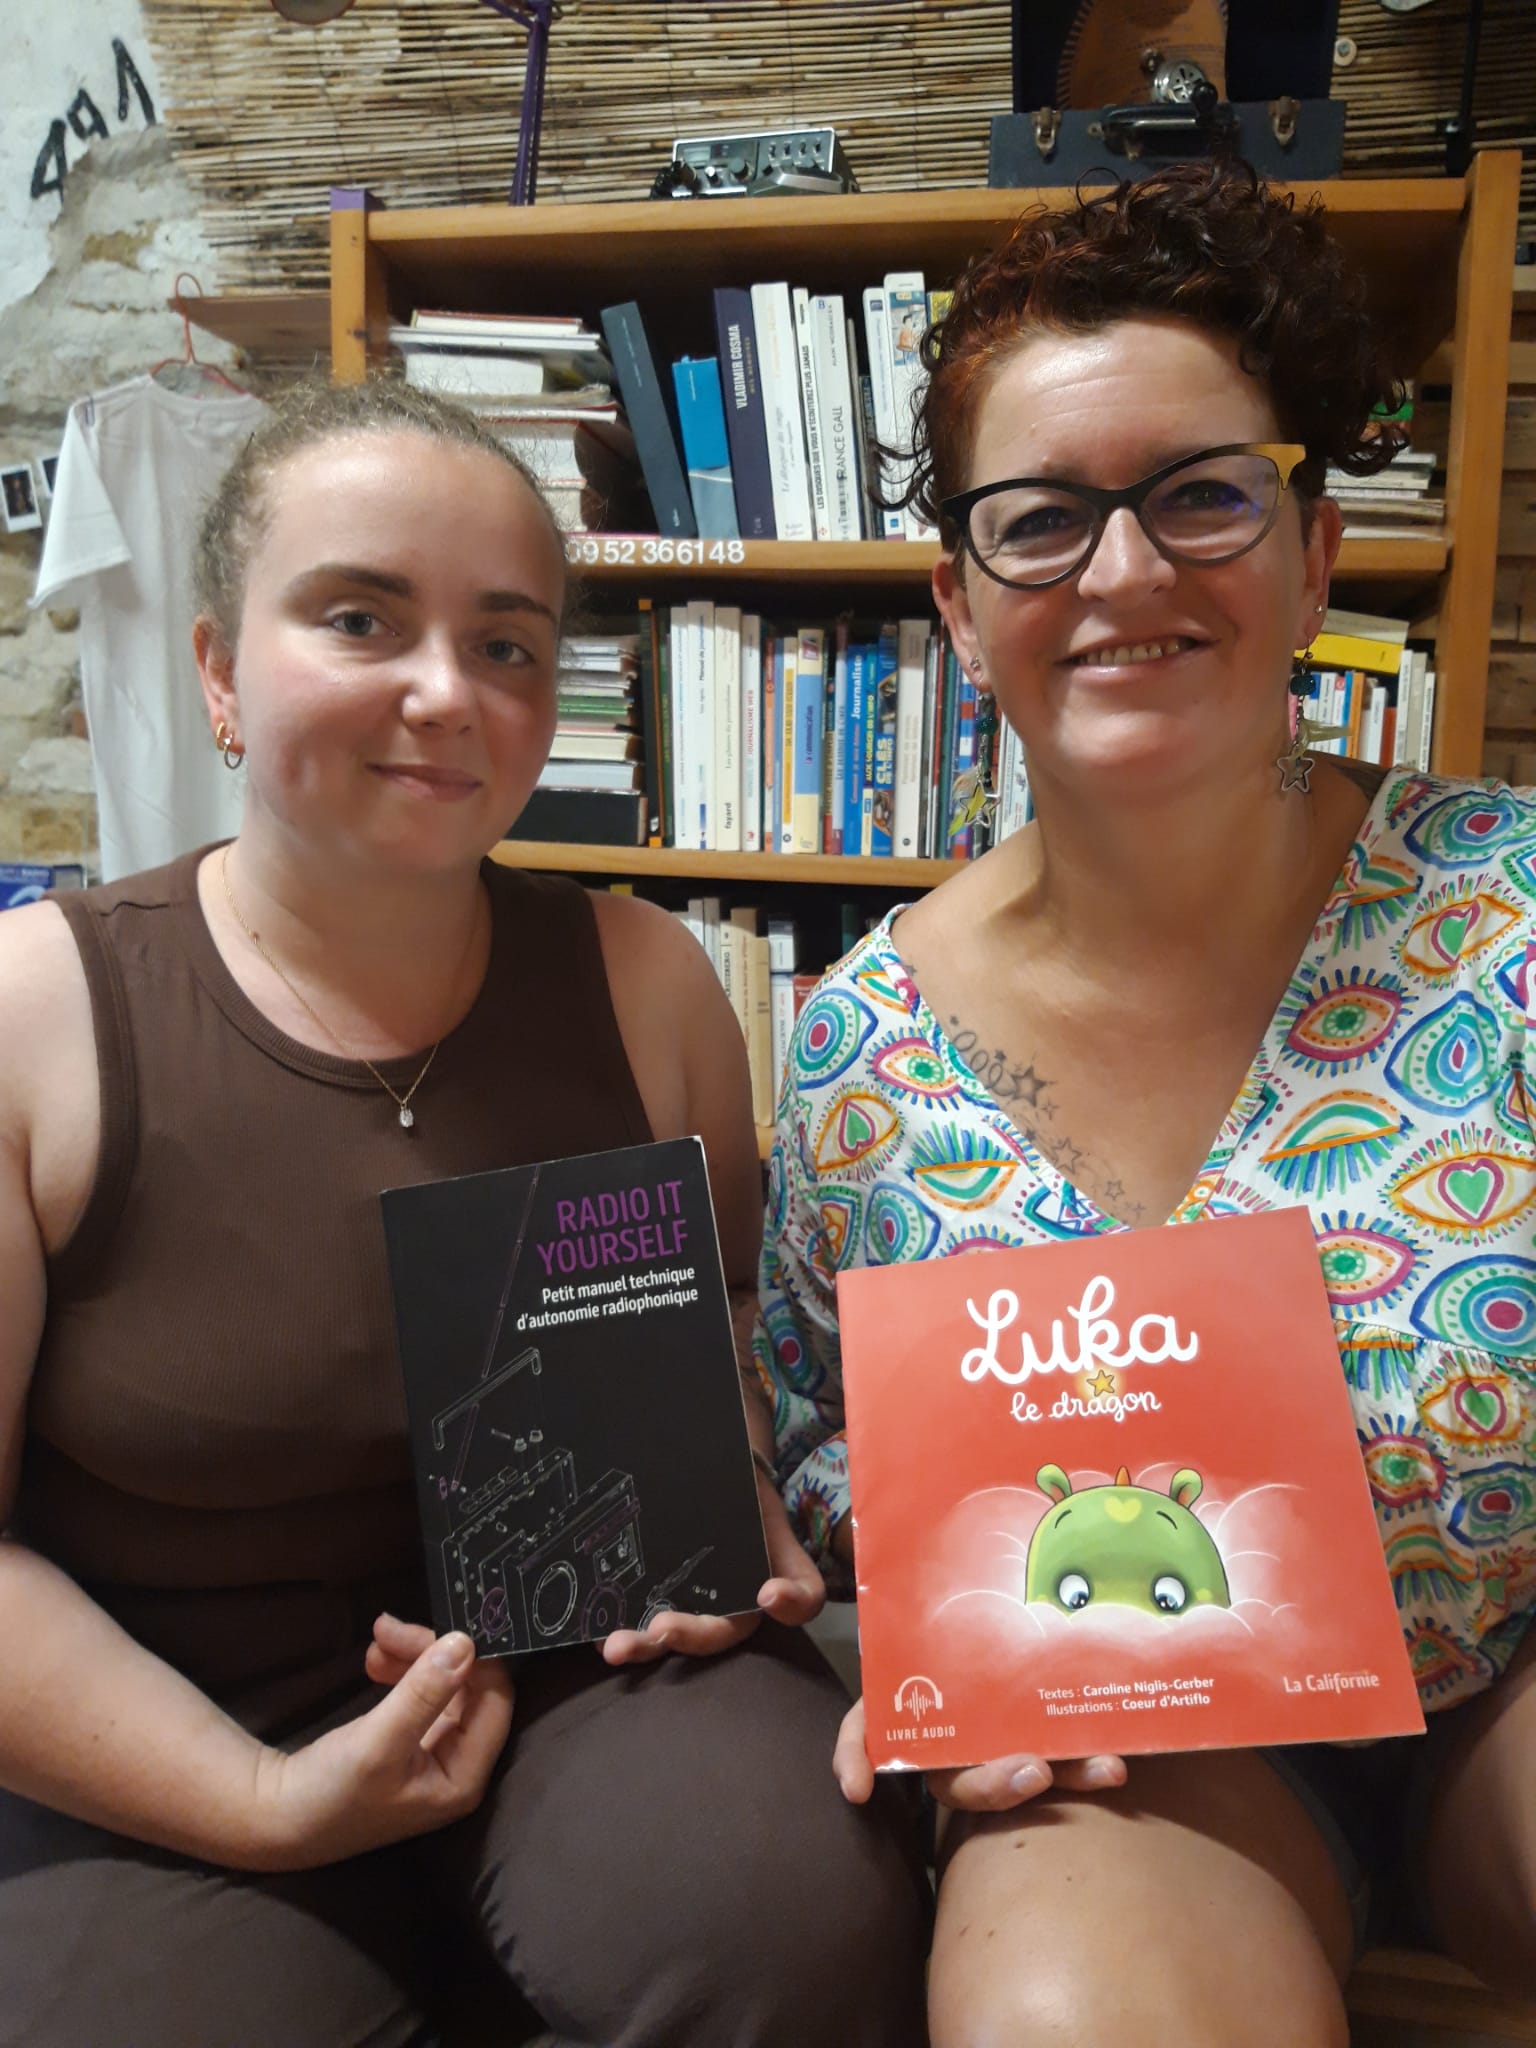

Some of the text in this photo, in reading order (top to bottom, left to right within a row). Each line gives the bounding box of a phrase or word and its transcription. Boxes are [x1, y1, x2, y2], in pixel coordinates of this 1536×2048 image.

[728, 324, 748, 409] VLADIMIR COSMA
[832, 405, 844, 433] GALL
[833, 436, 848, 480] FRANCE
[603, 540, 636, 564] 52
[851, 655, 863, 719] Journaliste
[724, 802, 733, 829] fayard
[556, 1180, 683, 1234] RADIO IT
[536, 1219, 689, 1276] YOURSELF
[542, 1267, 696, 1304] Petit manuel technique
[516, 1288, 699, 1331] d'autonomie radiophonique
[961, 1275, 1199, 1385] Luka
[1010, 1390, 1162, 1422] le dragon
[1037, 1688, 1075, 1701] Textes
[1082, 1682, 1132, 1697] Caroline
[1133, 1676, 1215, 1695] Niglis-Gerber
[1283, 1671, 1380, 1694] La Californie
[1046, 1701, 1113, 1716] Illustrations
[1159, 1692, 1211, 1708] d'Artiflo
[886, 1725, 956, 1741] LIVRE AUDIO
